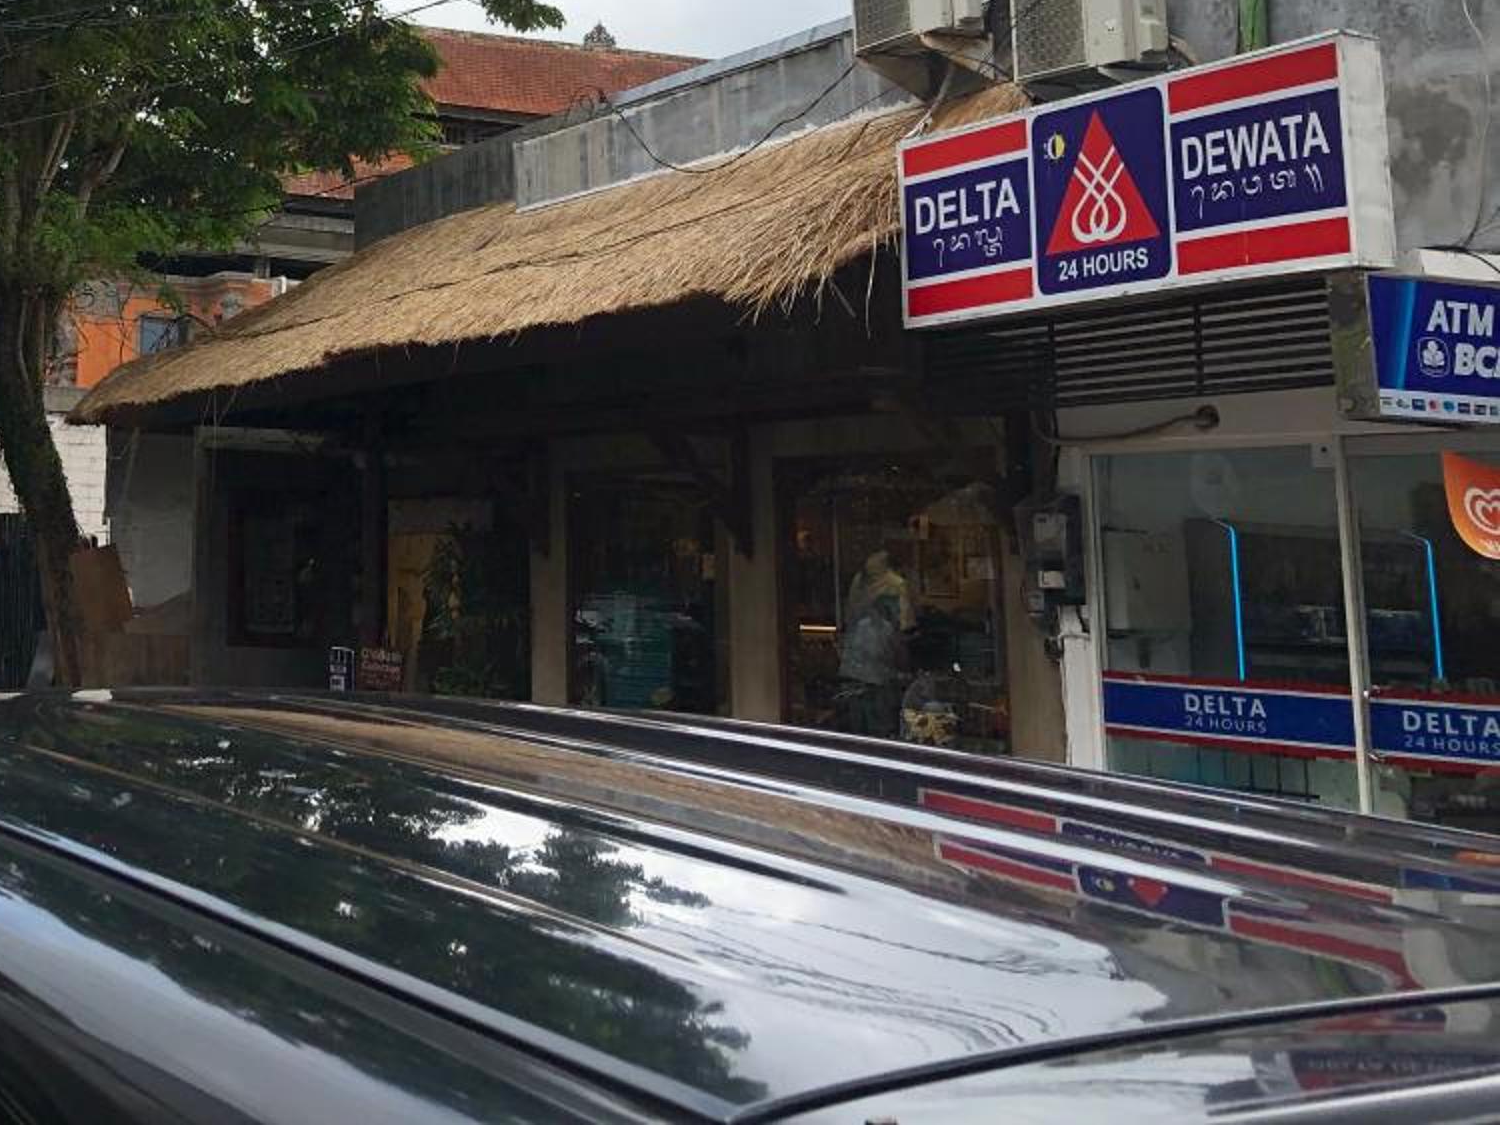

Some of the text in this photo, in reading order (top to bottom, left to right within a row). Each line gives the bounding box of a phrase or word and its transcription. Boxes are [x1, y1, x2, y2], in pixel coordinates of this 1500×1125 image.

[1181, 111, 1330, 180] DEWATA
[915, 178, 1021, 235] DELTA
[1058, 247, 1149, 281] 24 HOURS
[1426, 300, 1495, 337] ATM
[1453, 342, 1500, 378] BC
[1183, 692, 1268, 718] DELTA
[1209, 717, 1268, 734] HOURS
[1402, 710, 1500, 737] DELTA
[1403, 734, 1500, 754] 24 HOURS
